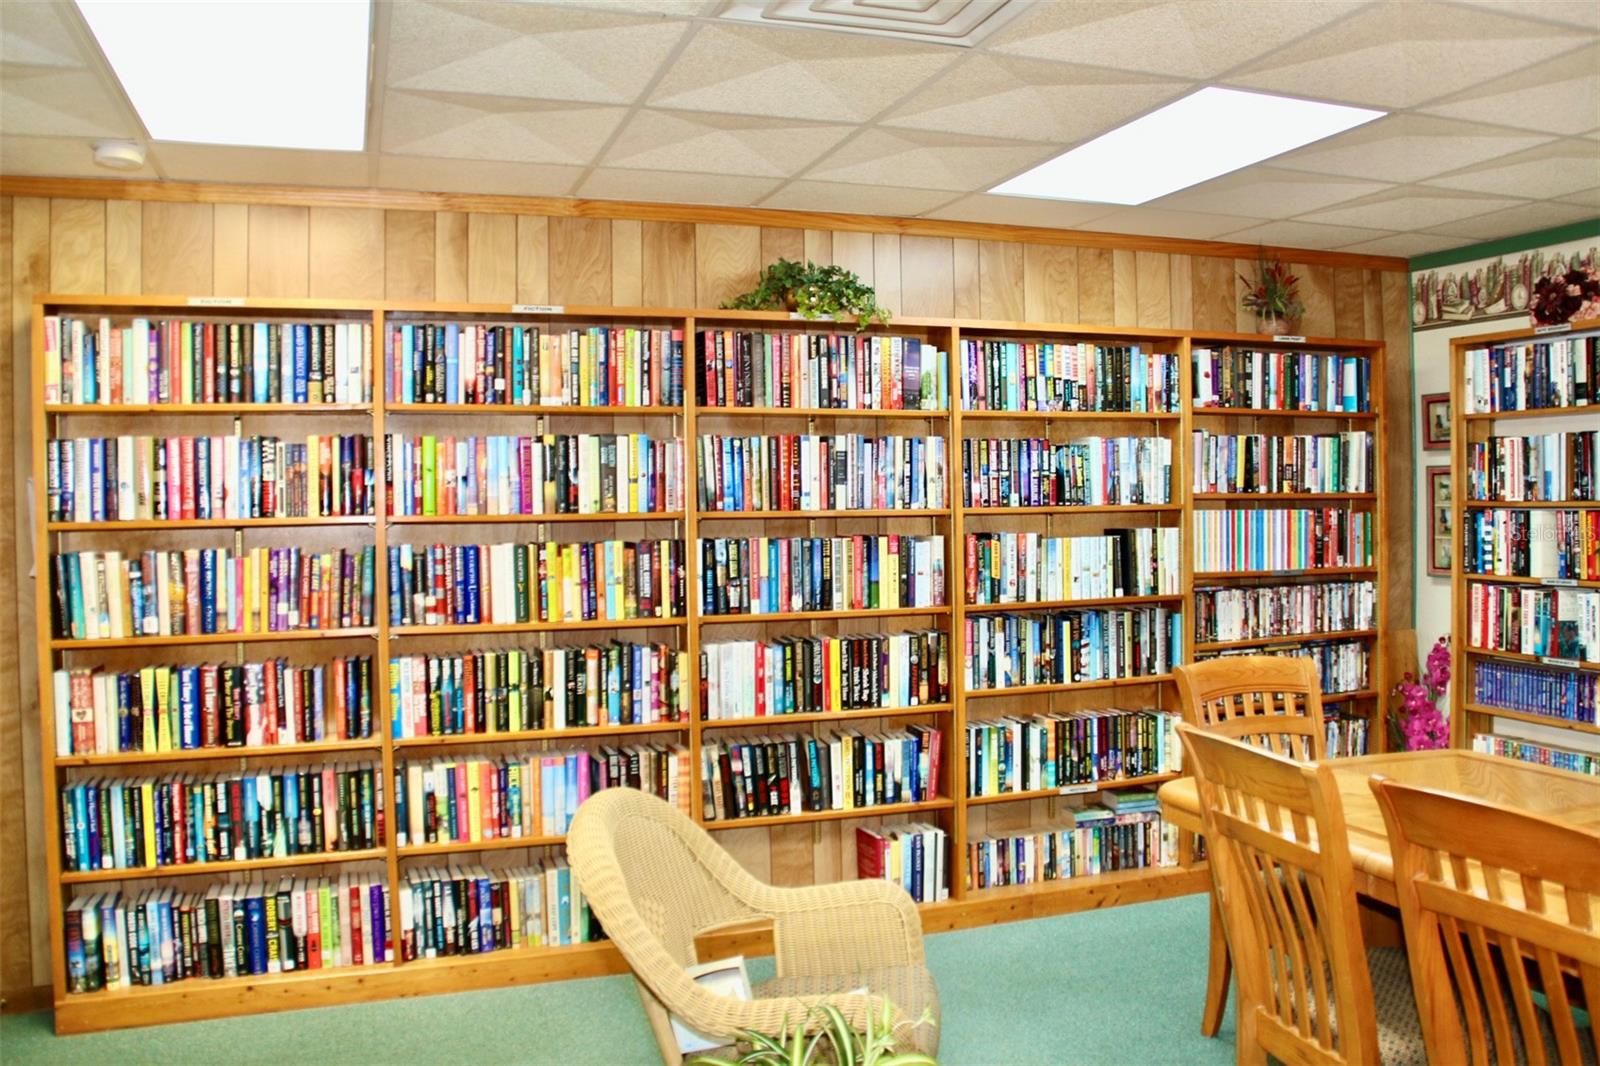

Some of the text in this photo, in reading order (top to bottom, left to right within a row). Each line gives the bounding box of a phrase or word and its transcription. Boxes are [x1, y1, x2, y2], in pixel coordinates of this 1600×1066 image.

[296, 326, 305, 345] DAVID
[325, 326, 334, 344] DAVID
[296, 346, 305, 376] BALDACCI
[325, 346, 334, 374] BALDACCI
[183, 670, 192, 683] Tom
[205, 672, 216, 688] Tom
[181, 684, 192, 702] Clancy
[204, 688, 216, 712] Clancy
[266, 899, 278, 931] ROBERT
